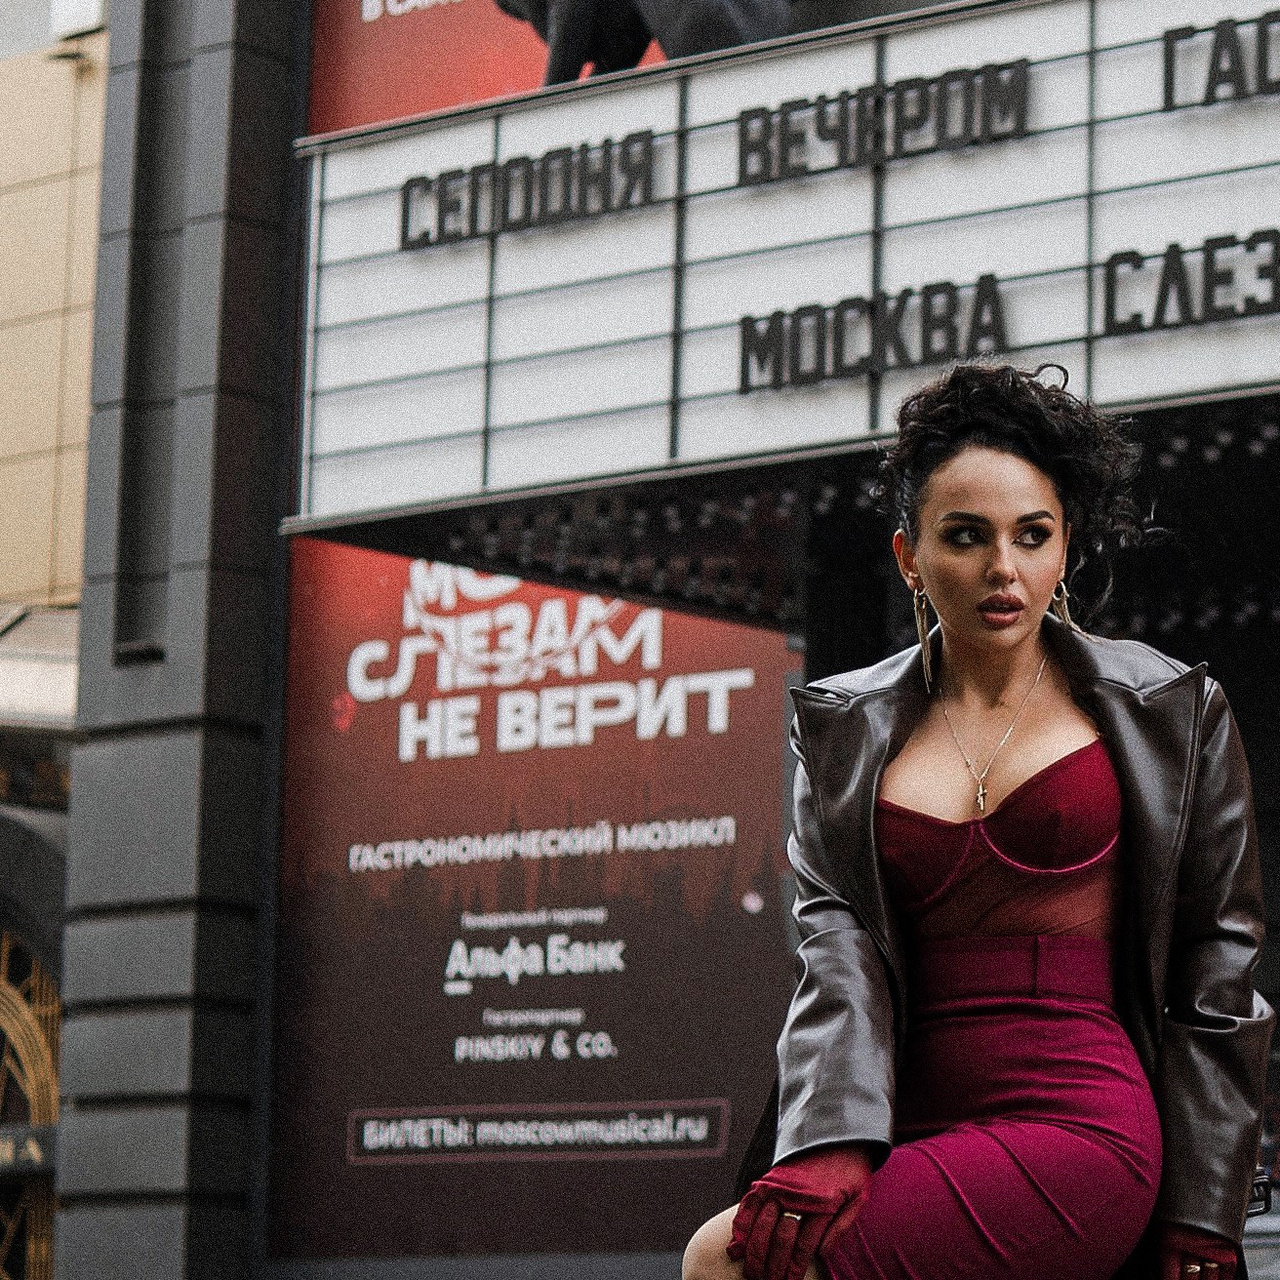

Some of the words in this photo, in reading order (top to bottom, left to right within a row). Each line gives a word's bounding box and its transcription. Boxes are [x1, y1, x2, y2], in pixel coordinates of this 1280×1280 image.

[400, 131, 656, 251] СЕГОДНЯ
[737, 58, 1030, 187] ВЕЧЕРОМ
[739, 273, 1008, 394] МОСКВА
[400, 694, 481, 763] НЕ
[496, 666, 756, 754] ВЕРИТ
[348, 820, 613, 872] ГАСТРОНОМИЧЕСКИЙ
[617, 815, 737, 852] МЮЗИКЛ
